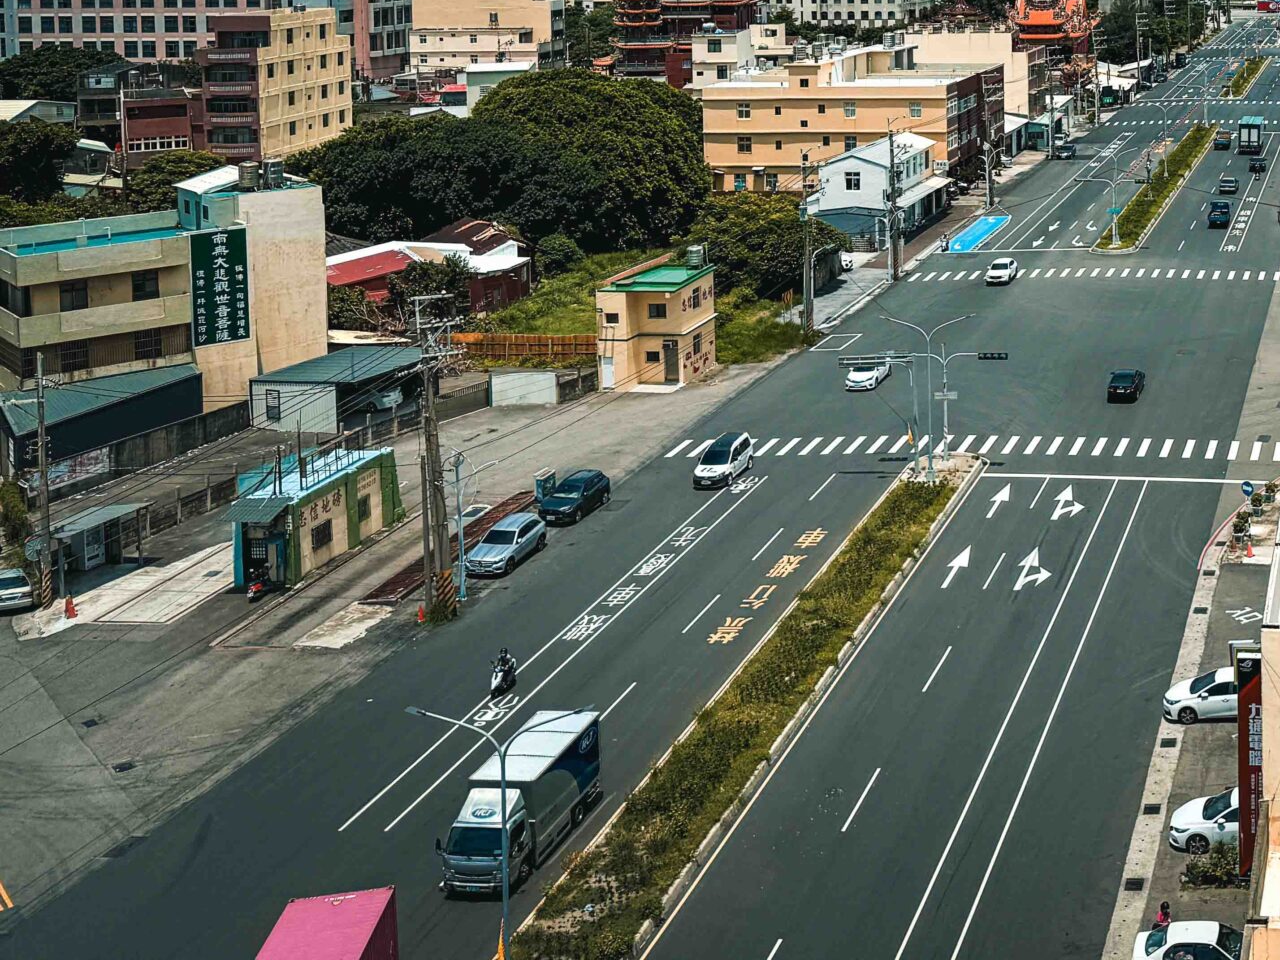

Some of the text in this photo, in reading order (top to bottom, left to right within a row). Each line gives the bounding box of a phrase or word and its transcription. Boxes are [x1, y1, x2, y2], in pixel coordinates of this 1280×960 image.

[211, 232, 231, 342] 南無大悲觀世音菩薩
[706, 527, 829, 644] 禁行機車
